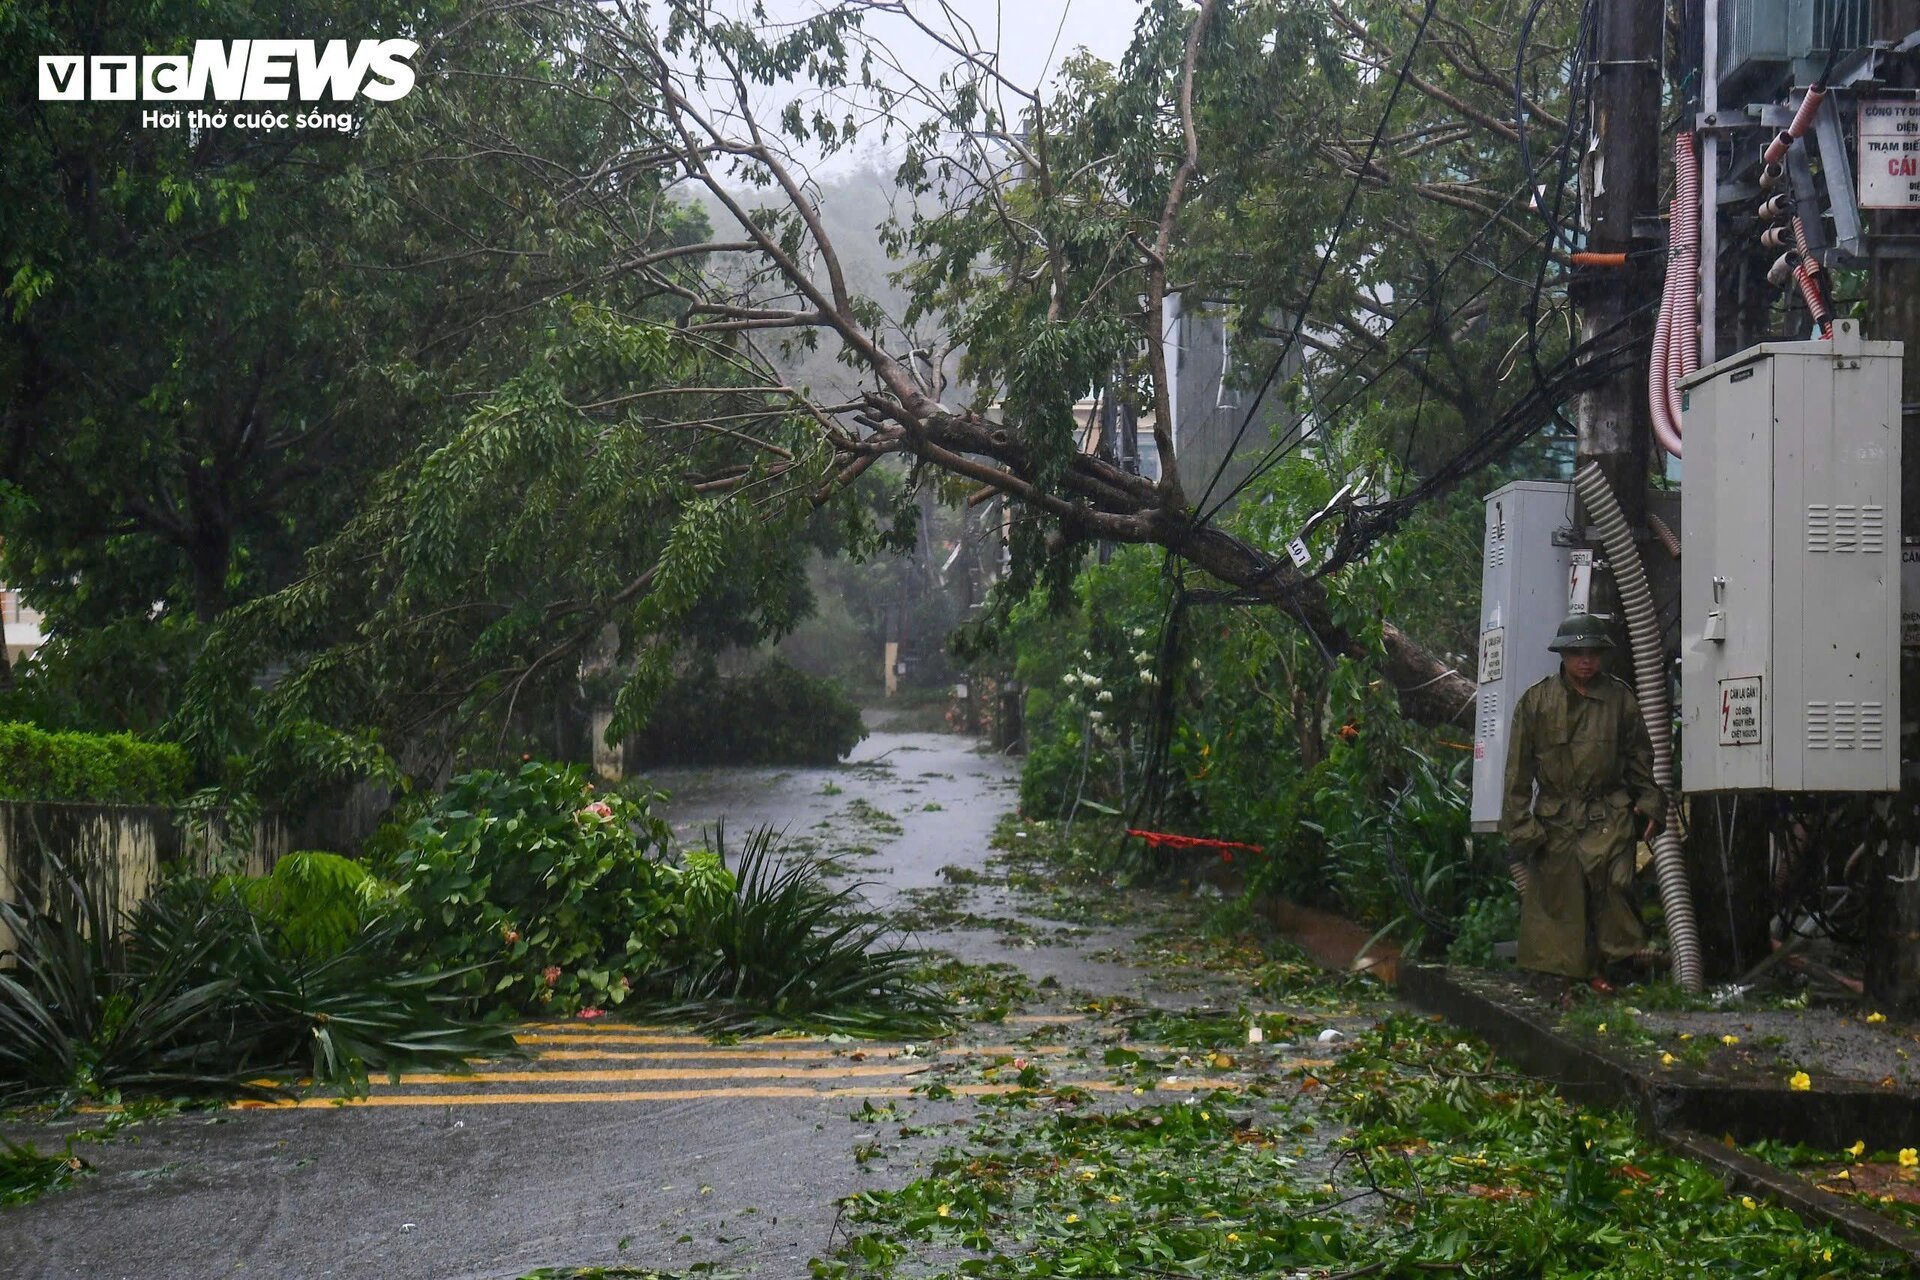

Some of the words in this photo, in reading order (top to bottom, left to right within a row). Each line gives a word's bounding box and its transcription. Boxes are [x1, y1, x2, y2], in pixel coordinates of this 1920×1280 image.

[1865, 105, 1892, 117] CÔNG
[1895, 107, 1907, 117] TY
[1868, 142, 1900, 154] TRẠM
[1888, 156, 1917, 177] CÁI
